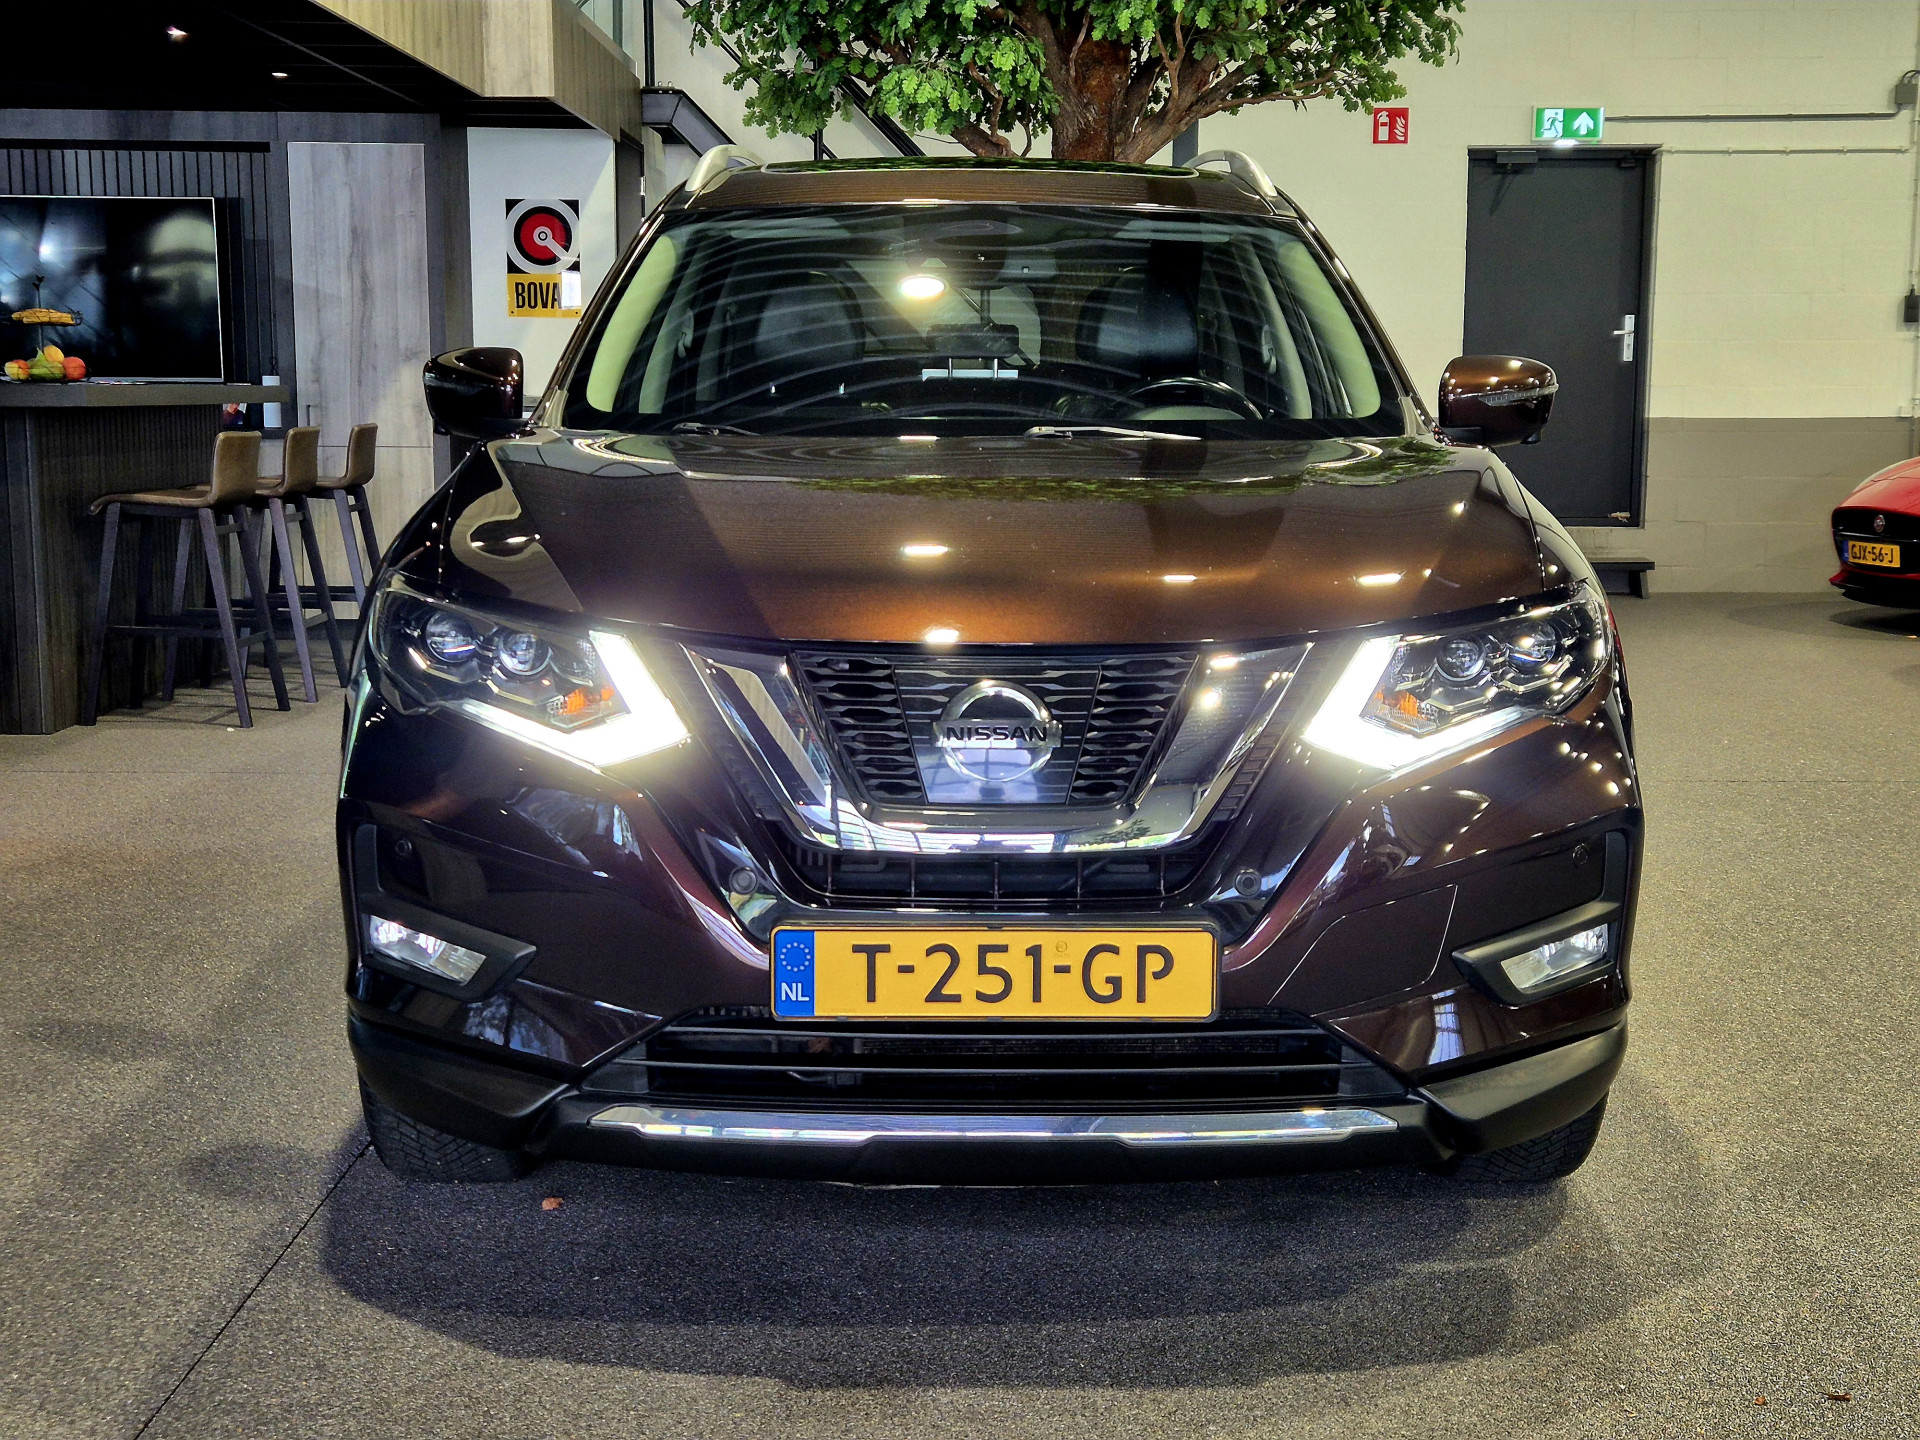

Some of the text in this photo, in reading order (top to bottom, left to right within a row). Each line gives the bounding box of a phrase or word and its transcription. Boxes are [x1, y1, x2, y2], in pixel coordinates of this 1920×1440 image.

[514, 281, 563, 309] BOVA
[1850, 543, 1894, 563] GJX-56-J
[946, 726, 1048, 742] NISSAN
[851, 943, 1175, 1004] T-251-GP
[781, 982, 810, 1001] NL
